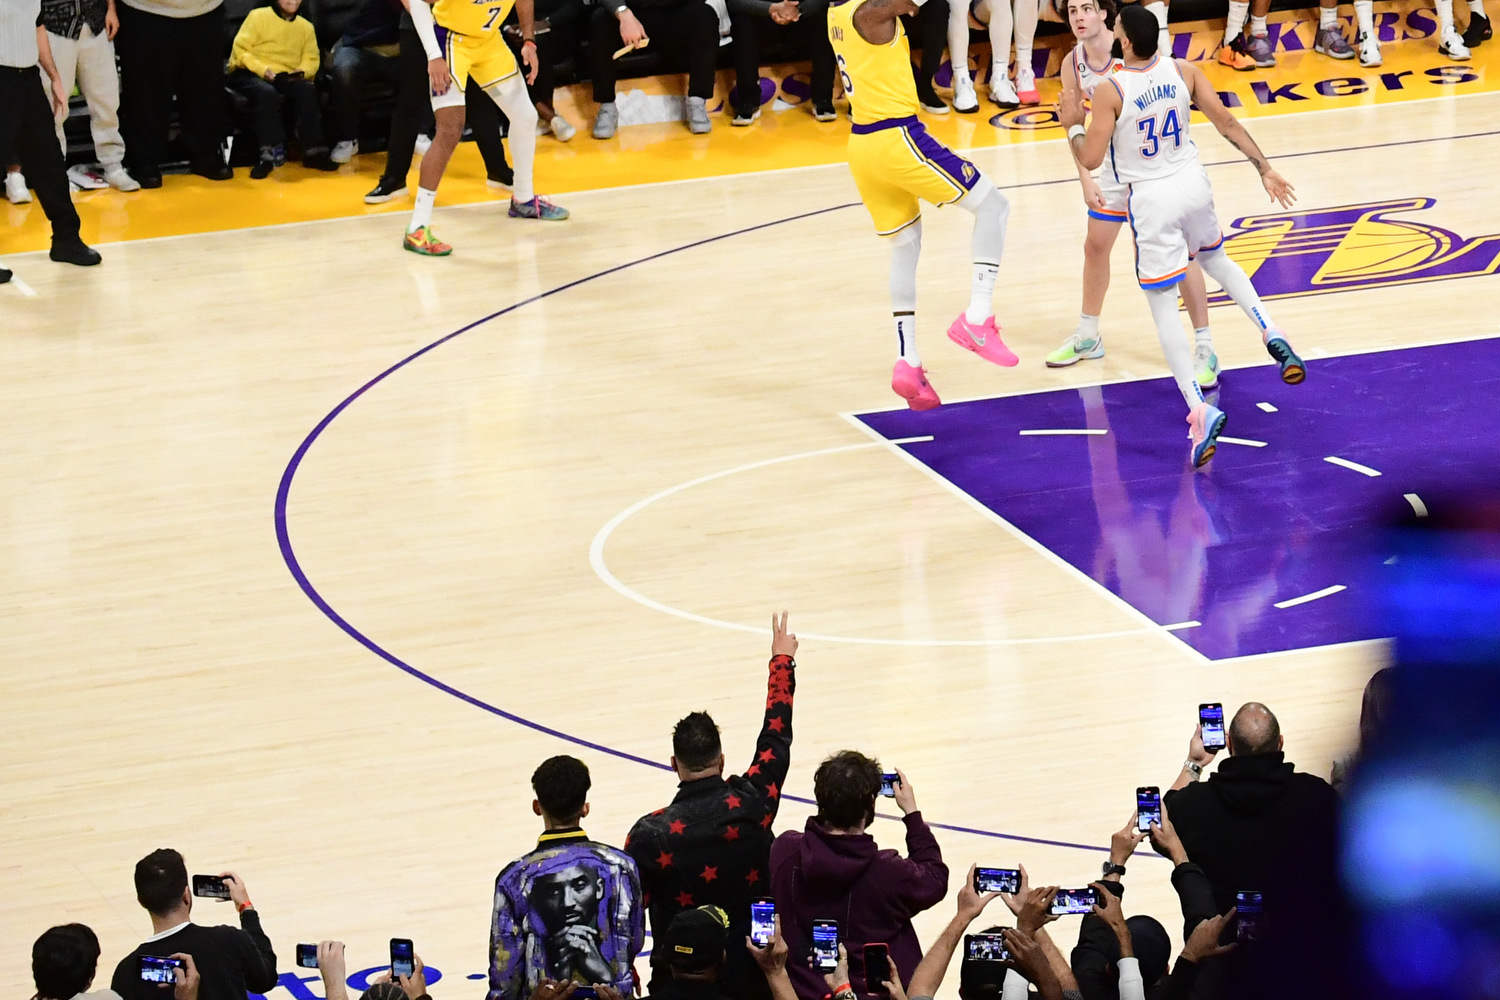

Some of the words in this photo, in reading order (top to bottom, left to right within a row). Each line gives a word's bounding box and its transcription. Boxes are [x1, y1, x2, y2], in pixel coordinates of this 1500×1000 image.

[482, 6, 501, 29] 7
[1133, 84, 1177, 112] WILLIAMS
[1136, 105, 1184, 160] 34
